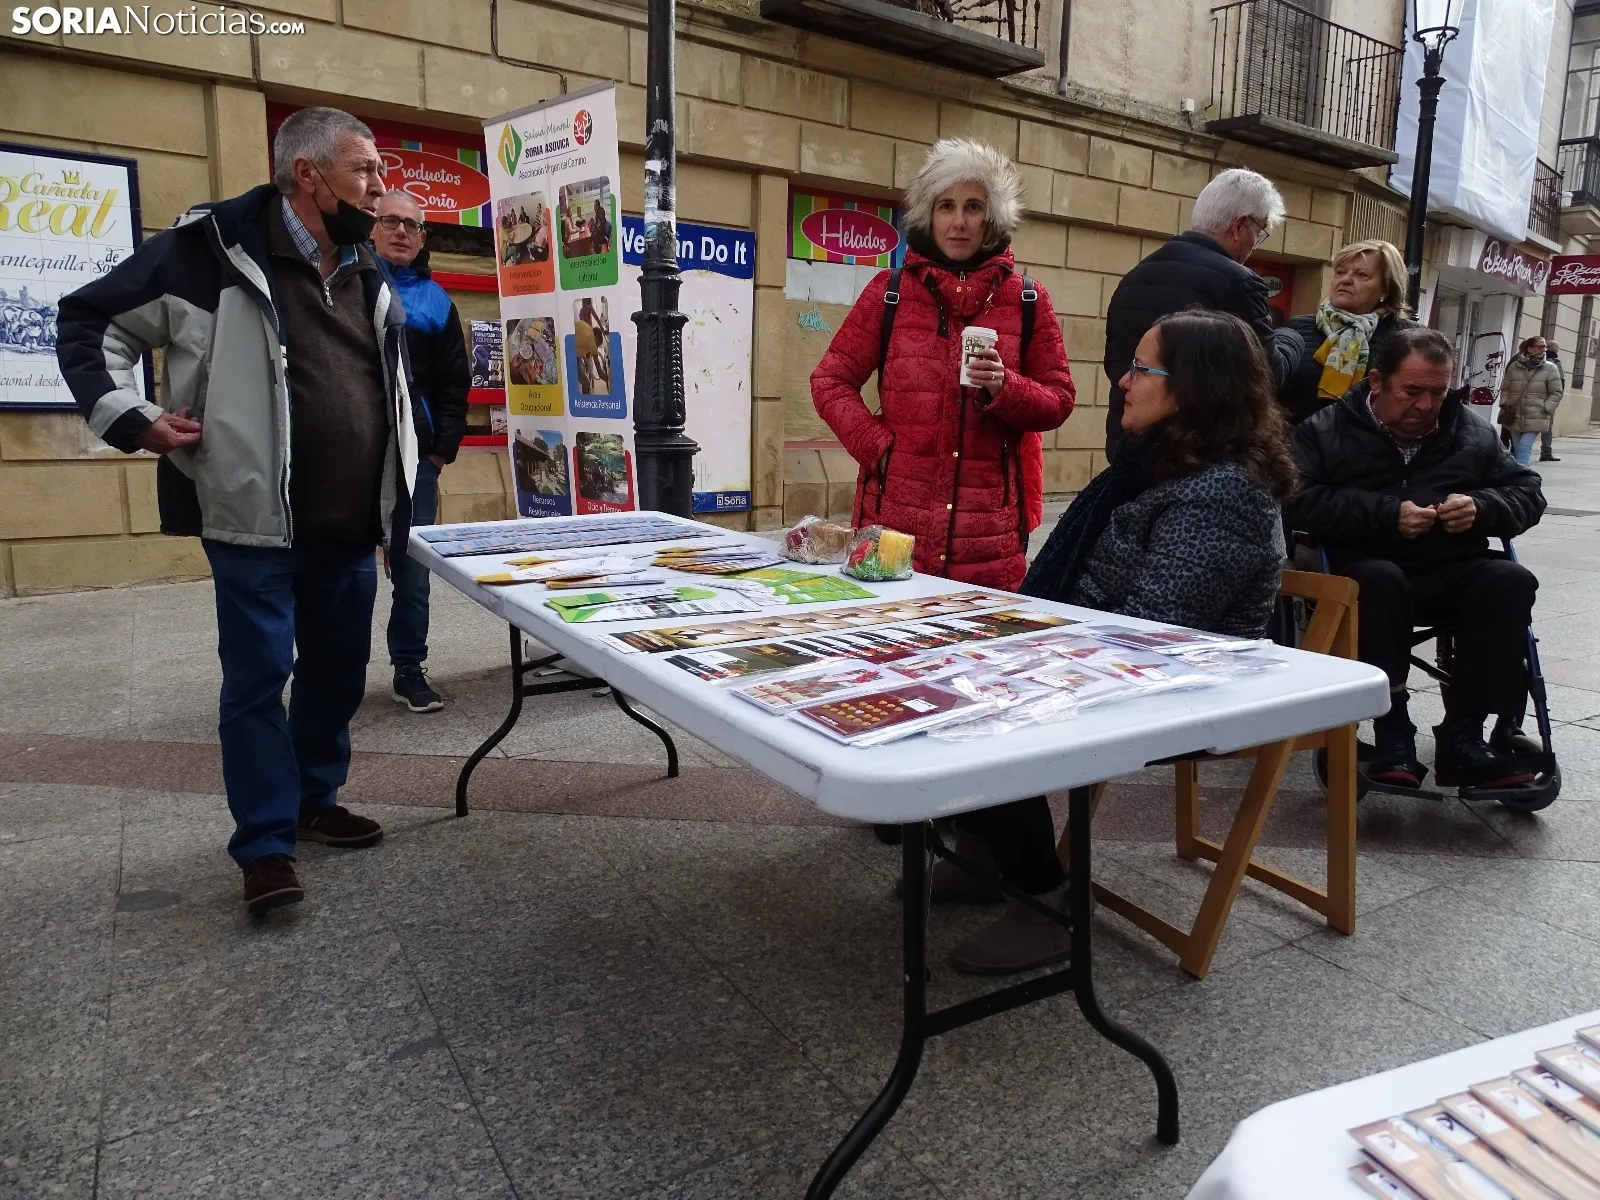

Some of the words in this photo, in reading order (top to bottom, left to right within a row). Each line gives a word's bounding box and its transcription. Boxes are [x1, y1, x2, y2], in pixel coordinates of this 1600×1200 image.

[523, 127, 546, 142] Salud
[546, 117, 571, 135] Mental
[525, 144, 544, 159] SORIA
[544, 137, 570, 153] ASOVICA
[378, 152, 461, 186] Productos
[20, 172, 101, 200] Cañada
[402, 180, 458, 209] Soria
[0, 175, 119, 239] Real
[820, 214, 887, 252] Helados
[105, 247, 125, 263] de
[700, 236, 728, 263] Do
[734, 240, 747, 265] It
[1482, 240, 1508, 275] Discos
[0, 254, 88, 275] antequilla
[1555, 262, 1600, 279] Disco
[34, 373, 64, 387] desde
[597, 400, 621, 410] Personal
[532, 494, 556, 506] Recursos
[724, 496, 747, 505] Soria
